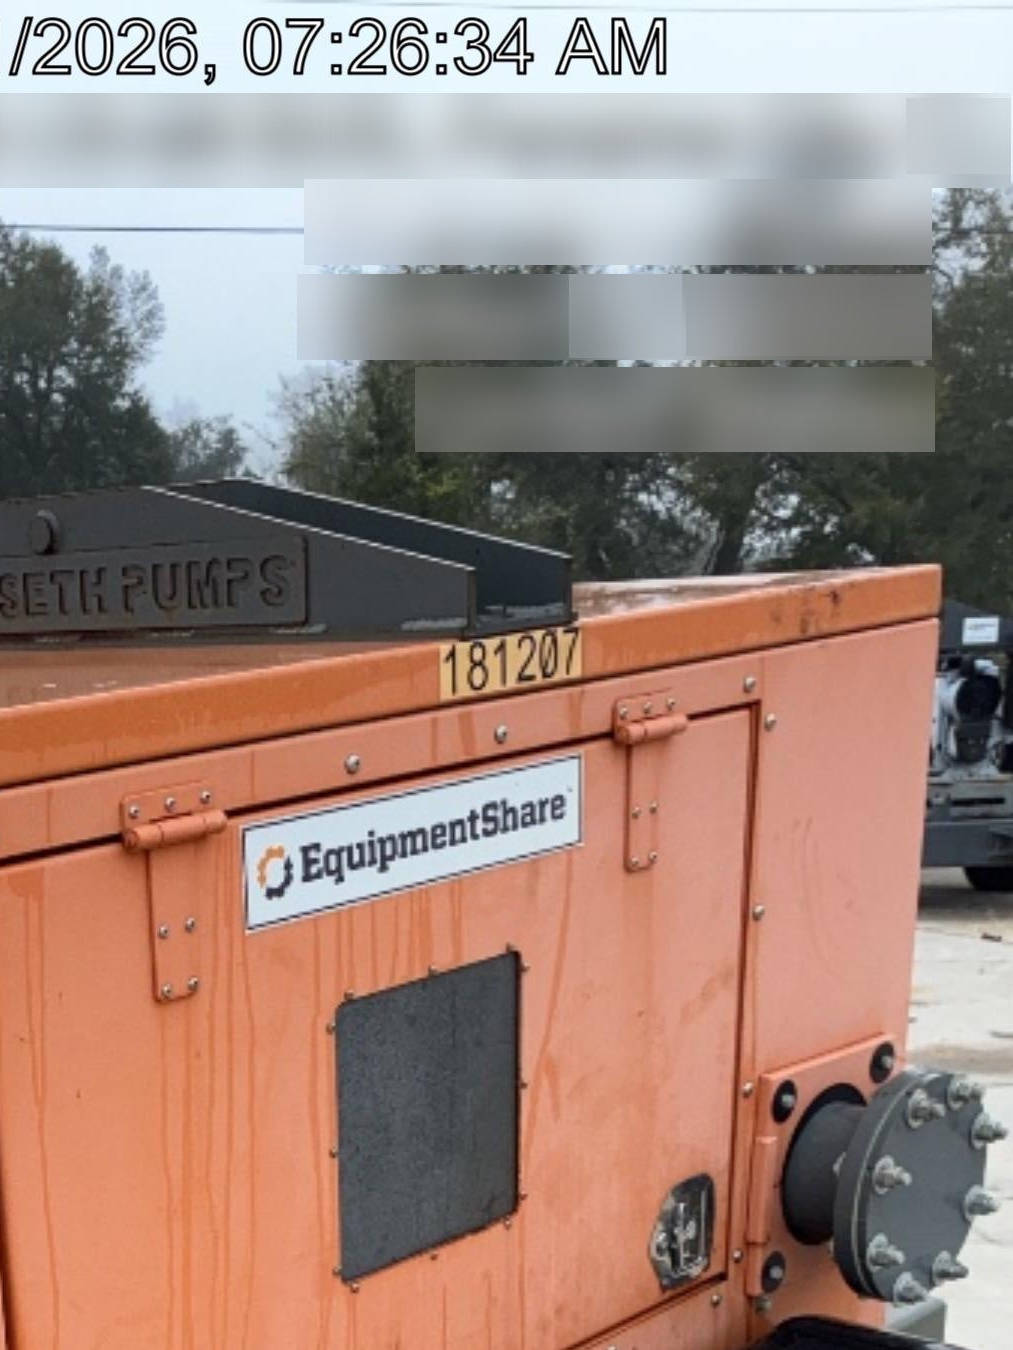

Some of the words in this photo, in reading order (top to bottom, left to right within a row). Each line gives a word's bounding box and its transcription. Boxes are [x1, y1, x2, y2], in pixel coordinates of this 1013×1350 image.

[120, 555, 288, 614] PUMPS
[444, 627, 580, 697] 181207
[299, 793, 567, 886] EquipmentShare
